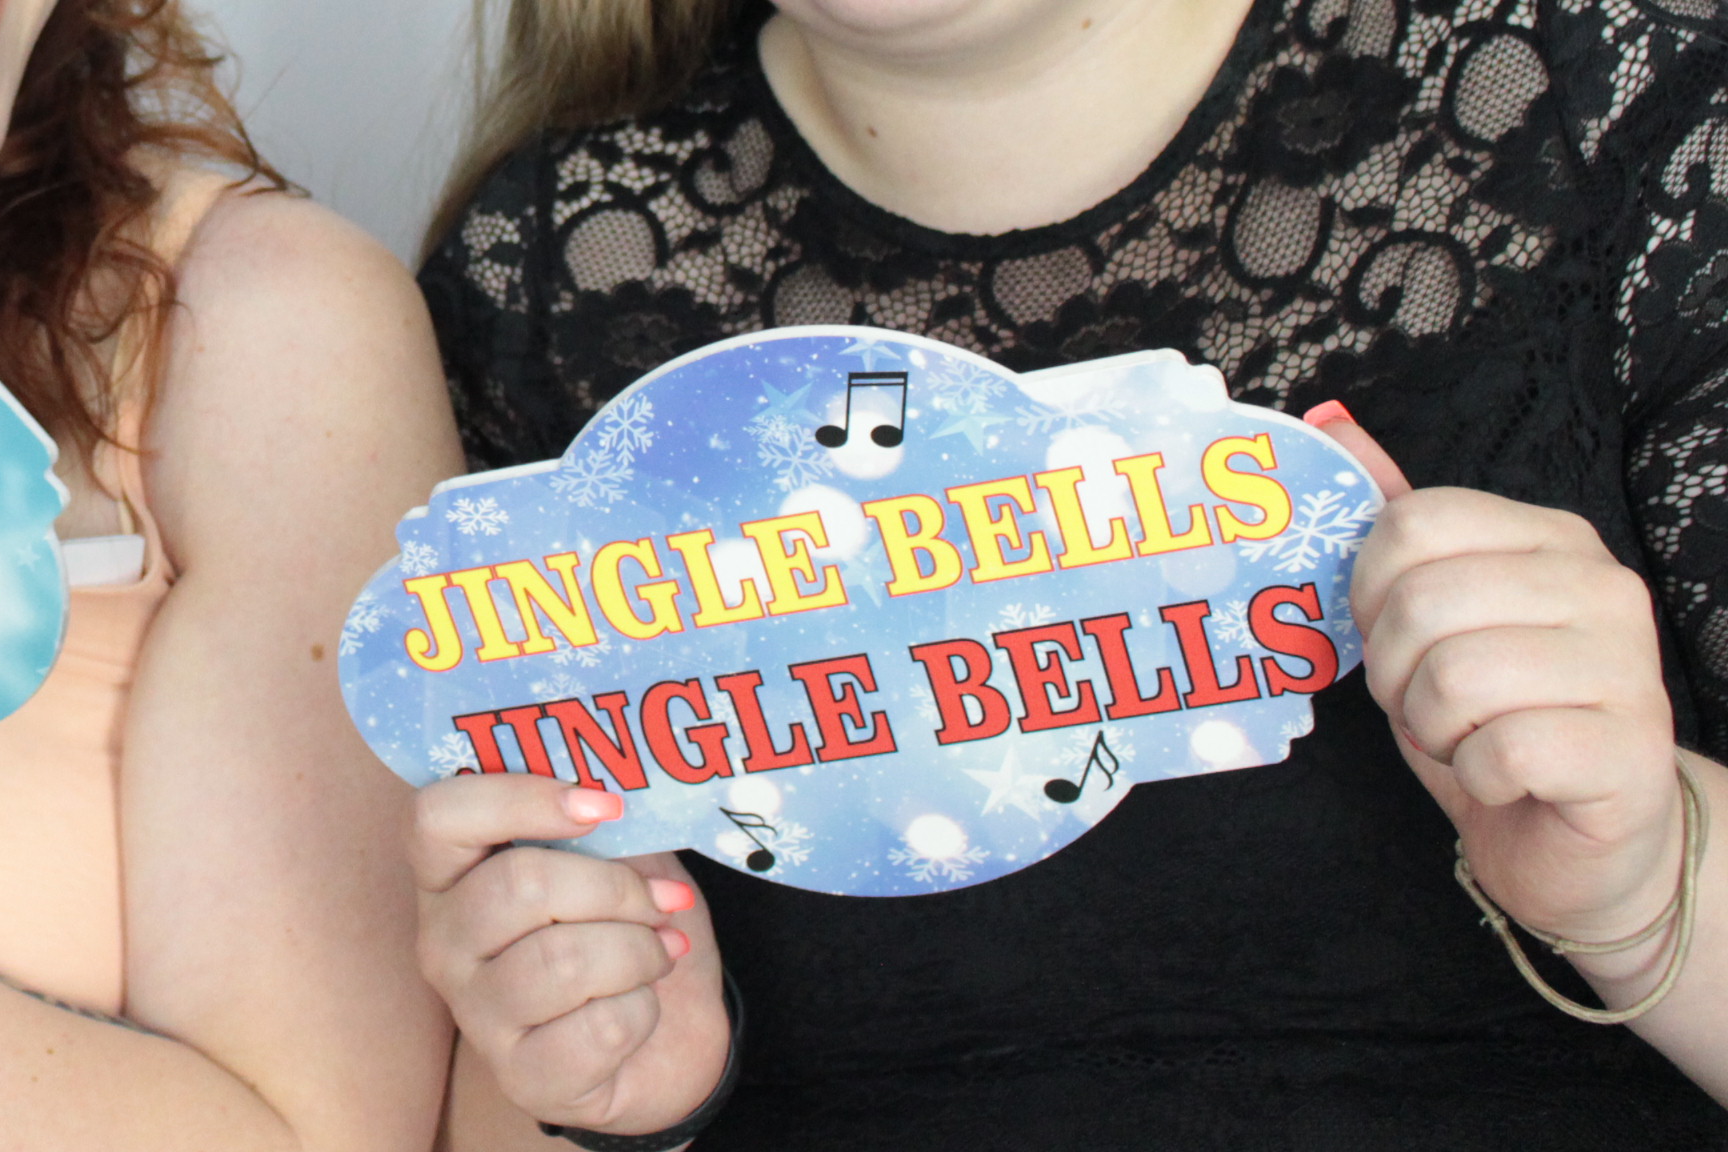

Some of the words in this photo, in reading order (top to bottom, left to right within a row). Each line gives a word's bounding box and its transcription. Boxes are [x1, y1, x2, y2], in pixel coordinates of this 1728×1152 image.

[404, 510, 848, 671] JINGLE
[863, 434, 1292, 598] BELLS
[910, 584, 1339, 746] BELLS
